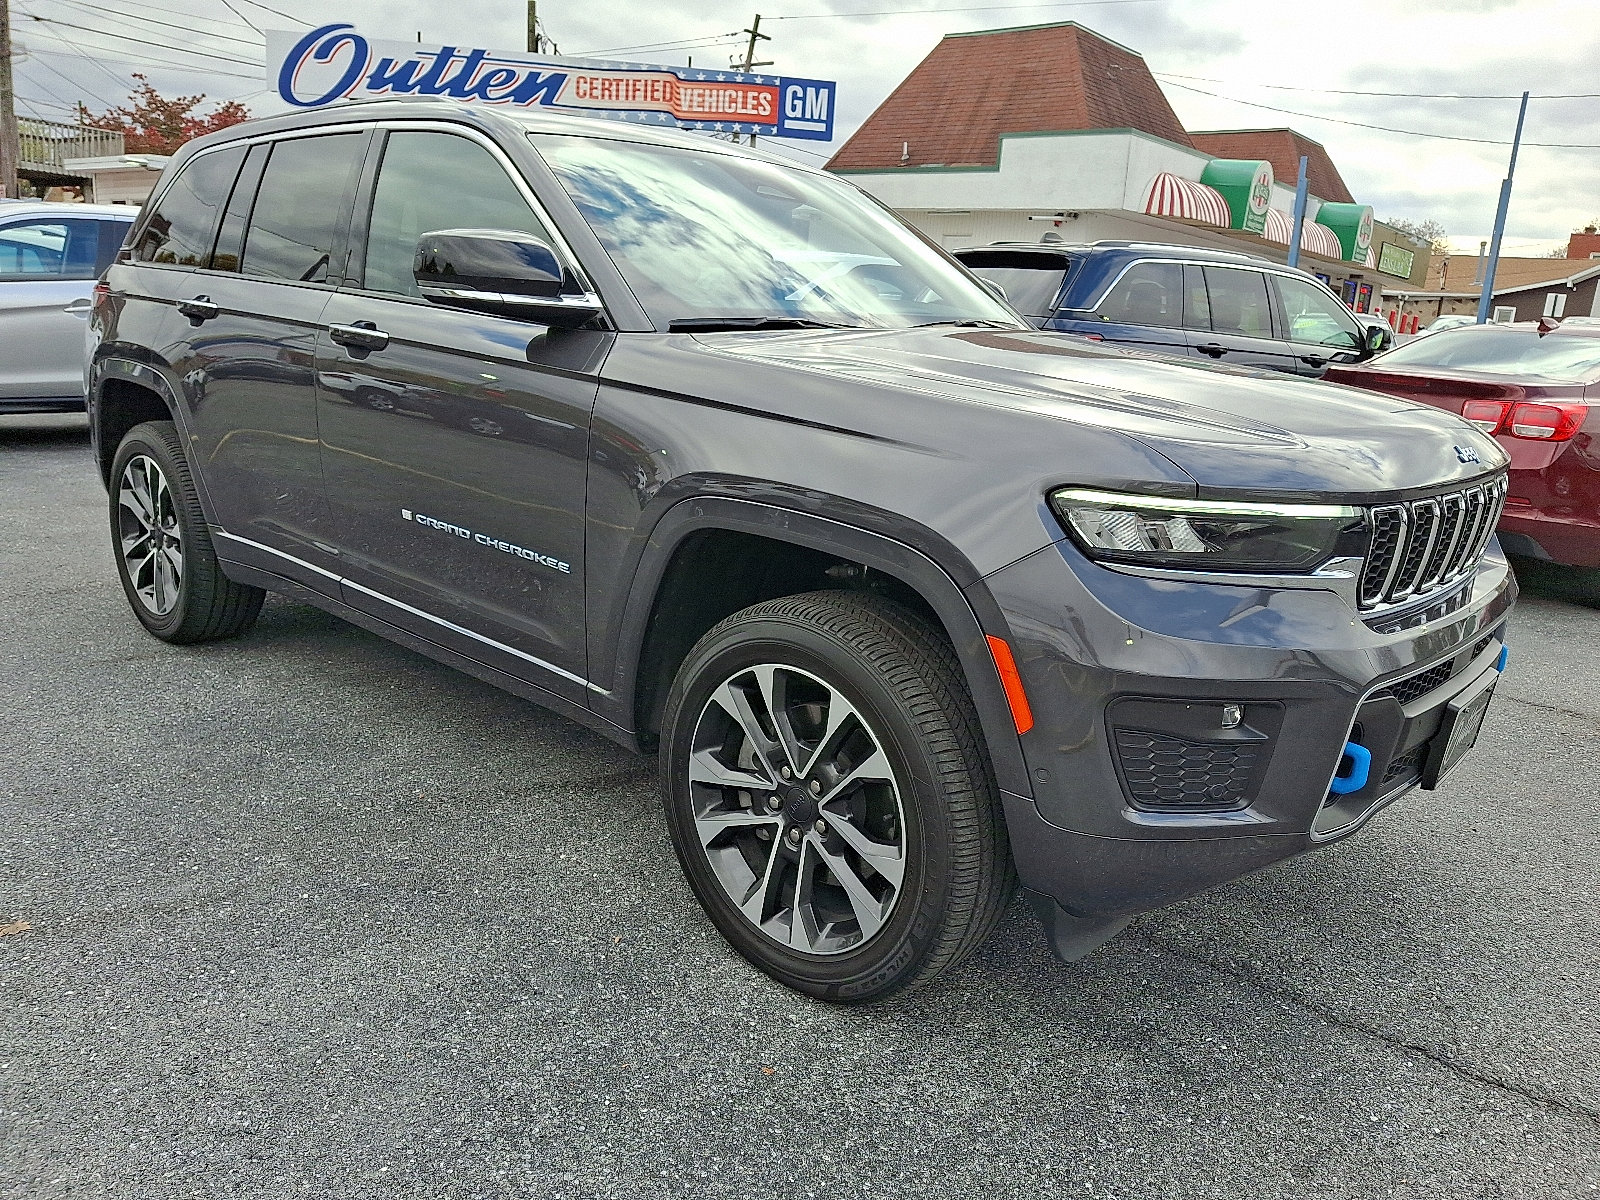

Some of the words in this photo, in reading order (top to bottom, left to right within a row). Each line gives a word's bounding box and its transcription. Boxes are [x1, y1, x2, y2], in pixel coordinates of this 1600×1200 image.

[278, 24, 569, 107] Outten
[575, 76, 674, 103] CERTIFIED
[679, 87, 772, 116] VEHICLES
[785, 85, 829, 121] GM
[415, 513, 471, 540] GRAND
[474, 533, 571, 574] CHEROKEE
